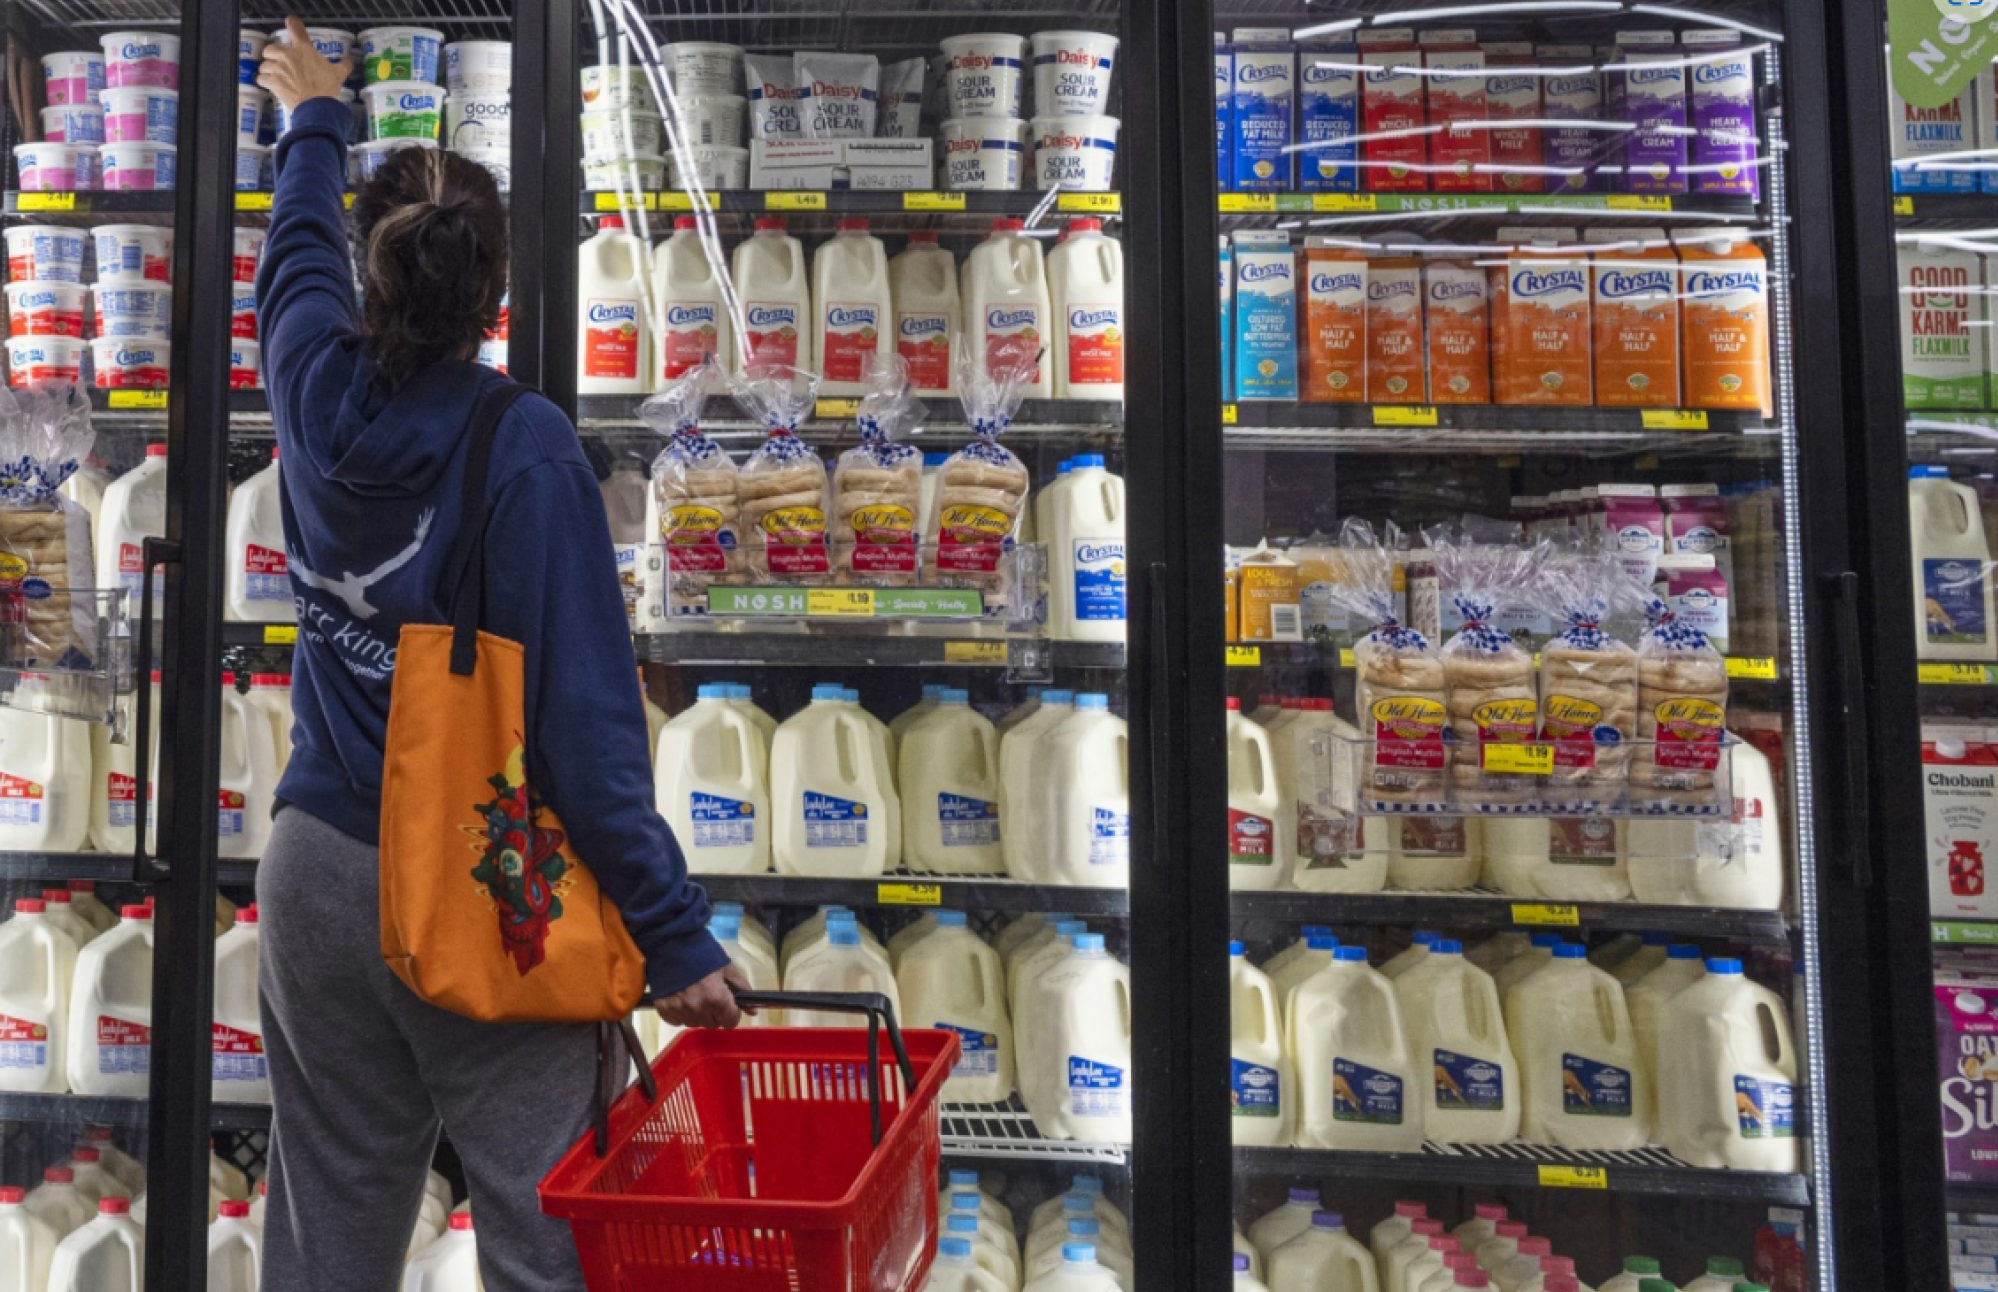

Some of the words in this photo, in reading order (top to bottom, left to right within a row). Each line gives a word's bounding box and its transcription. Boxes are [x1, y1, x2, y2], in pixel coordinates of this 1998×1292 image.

[953, 50, 993, 70] Daisy
[1056, 47, 1099, 70] Daisy
[957, 76, 990, 86] SOUR
[1059, 73, 1096, 86] SOUR
[1239, 64, 1289, 83] CRYSTAL
[1695, 63, 1748, 84] CRYSTAL
[812, 80, 861, 100] Daisy
[1055, 84, 1098, 98] CREAM
[1485, 76, 1534, 95] CRYSTAL
[817, 103, 859, 116] SOUR
[813, 116, 864, 130] CREAM
[1241, 121, 1286, 130] REDUCED
[1305, 121, 1351, 131] REDUCED
[1041, 127, 1085, 149] Daisy
[1243, 130, 1258, 140] FAT
[1259, 130, 1284, 140] MILK
[1493, 130, 1530, 140] WHOLE
[1905, 124, 1962, 141] FLAXMILK
[1500, 139, 1524, 150] MILK
[1642, 137, 1675, 148] CREAM
[1046, 156, 1081, 167] SOUR
[1044, 167, 1086, 180] CREAM
[1401, 198, 1468, 211] NOSH
[1240, 262, 1290, 282] CRYSTAL
[1311, 273, 1362, 293] CRYSTAL
[1367, 281, 1416, 300] CRYSTAL
[1431, 281, 1482, 300] CRYSTAL
[1512, 270, 1586, 297] CRYSTAL
[1599, 270, 1673, 298] CRYSTAL
[1687, 270, 1762, 298] CRYSTAL
[1910, 265, 1968, 309] GOOD
[589, 304, 636, 323] CRYSTAL
[667, 305, 715, 325] CRYSTAL
[748, 306, 796, 326] CRYSTAL
[827, 307, 875, 326] CRYSTAL
[987, 310, 1036, 329] CRYSTAL
[1070, 309, 1118, 328] CRYSTAL
[900, 318, 947, 336] CRYSTAL
[1911, 310, 1970, 336] KARMA
[1320, 329, 1343, 340] HALF
[1377, 336, 1401, 346] HALF
[1440, 336, 1465, 346] HALF
[1532, 331, 1555, 341] HALF
[1619, 331, 1644, 342] HALF
[1709, 332, 1735, 343] HALF
[1325, 339, 1350, 350] HALF
[1383, 345, 1408, 355] HALF
[1445, 345, 1471, 355] HALF
[1537, 340, 1563, 350] HALF
[1625, 341, 1651, 352] HALF
[1715, 342, 1742, 353] HALF
[1912, 337, 1970, 356] FLAXMILK
[1246, 568, 1276, 579] LOCAL
[1267, 578, 1294, 588] FRESH
[733, 594, 803, 610] NOSH
[1927, 772, 1995, 788] Chobani
[1941, 1077, 1998, 1138] Sil
